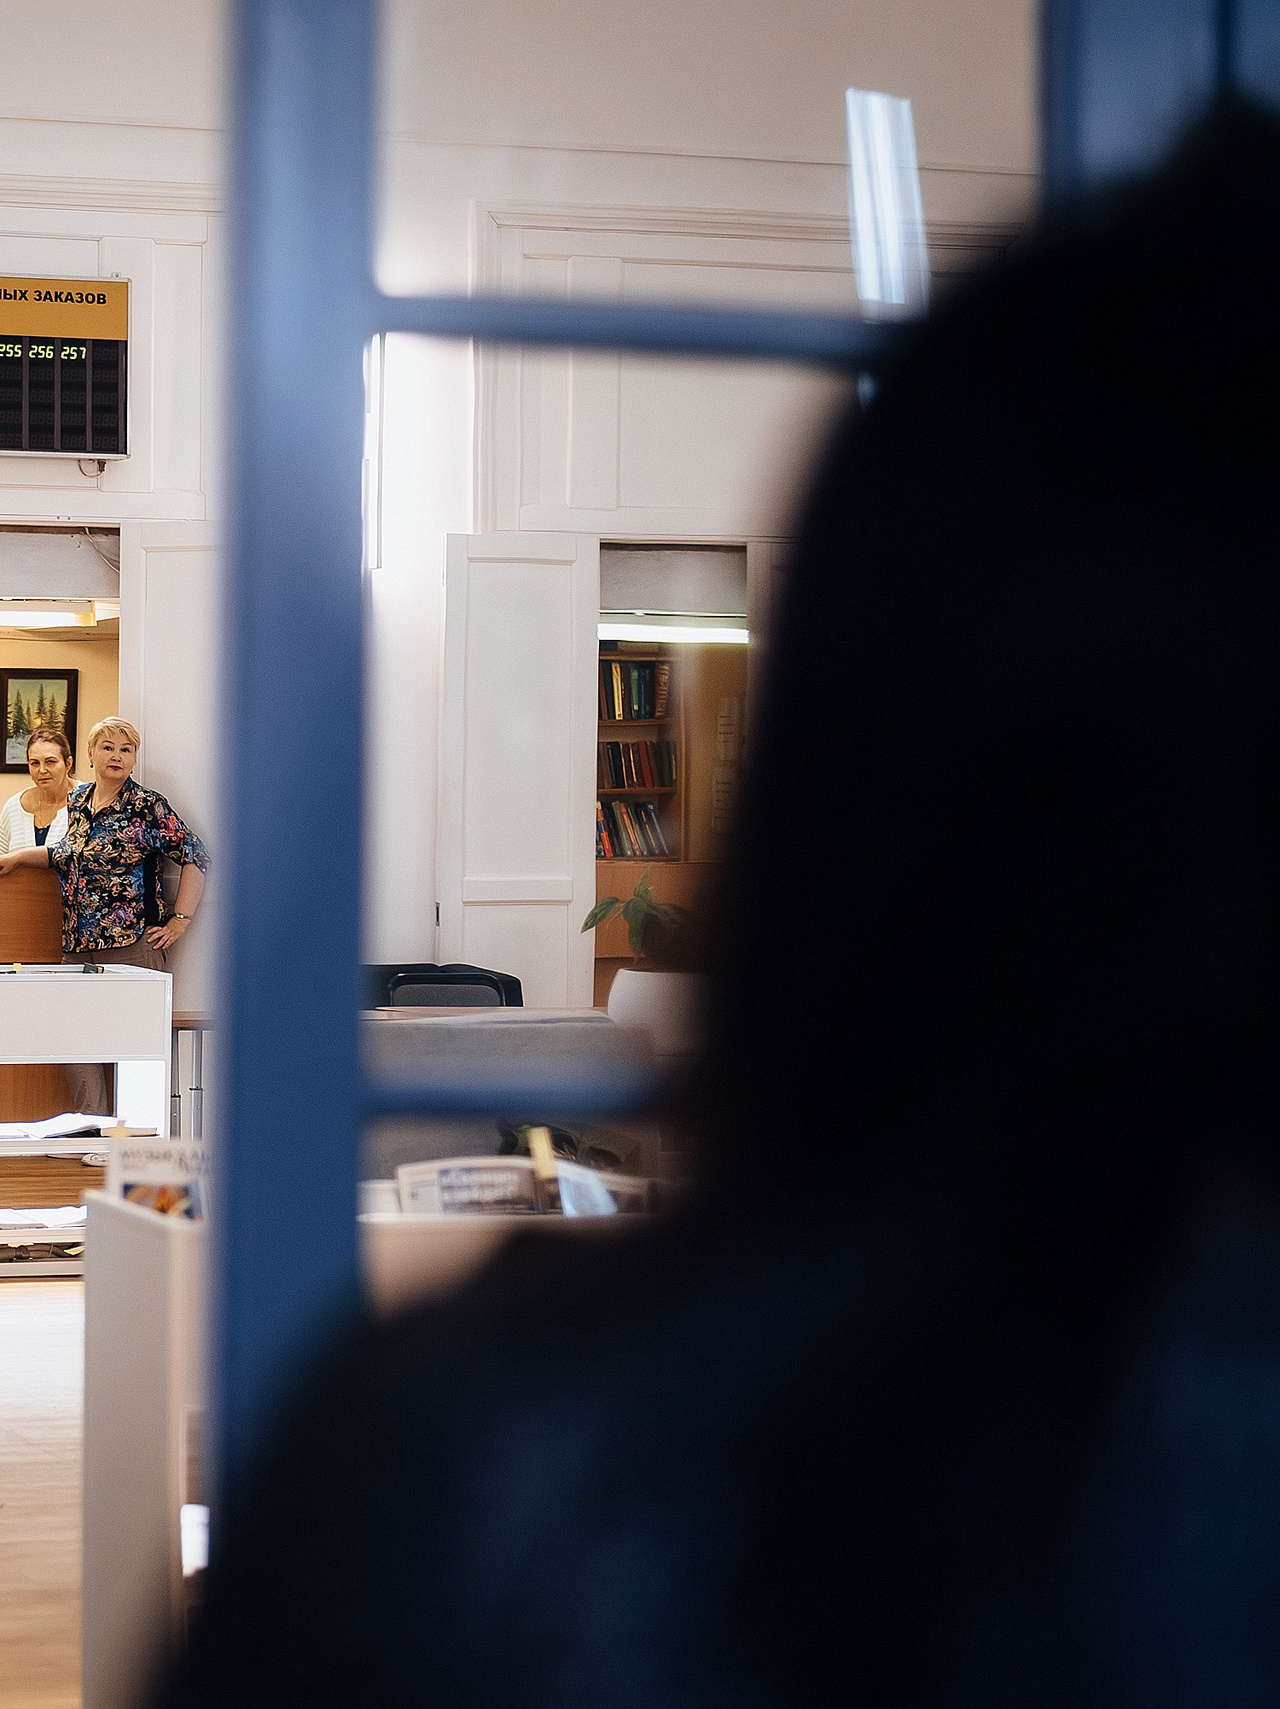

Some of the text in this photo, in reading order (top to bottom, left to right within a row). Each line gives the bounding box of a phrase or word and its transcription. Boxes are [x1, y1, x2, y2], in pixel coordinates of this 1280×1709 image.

[33, 290, 107, 304] ЗАКАЗОВ
[28, 345, 54, 359] 256
[60, 346, 87, 360] 257
